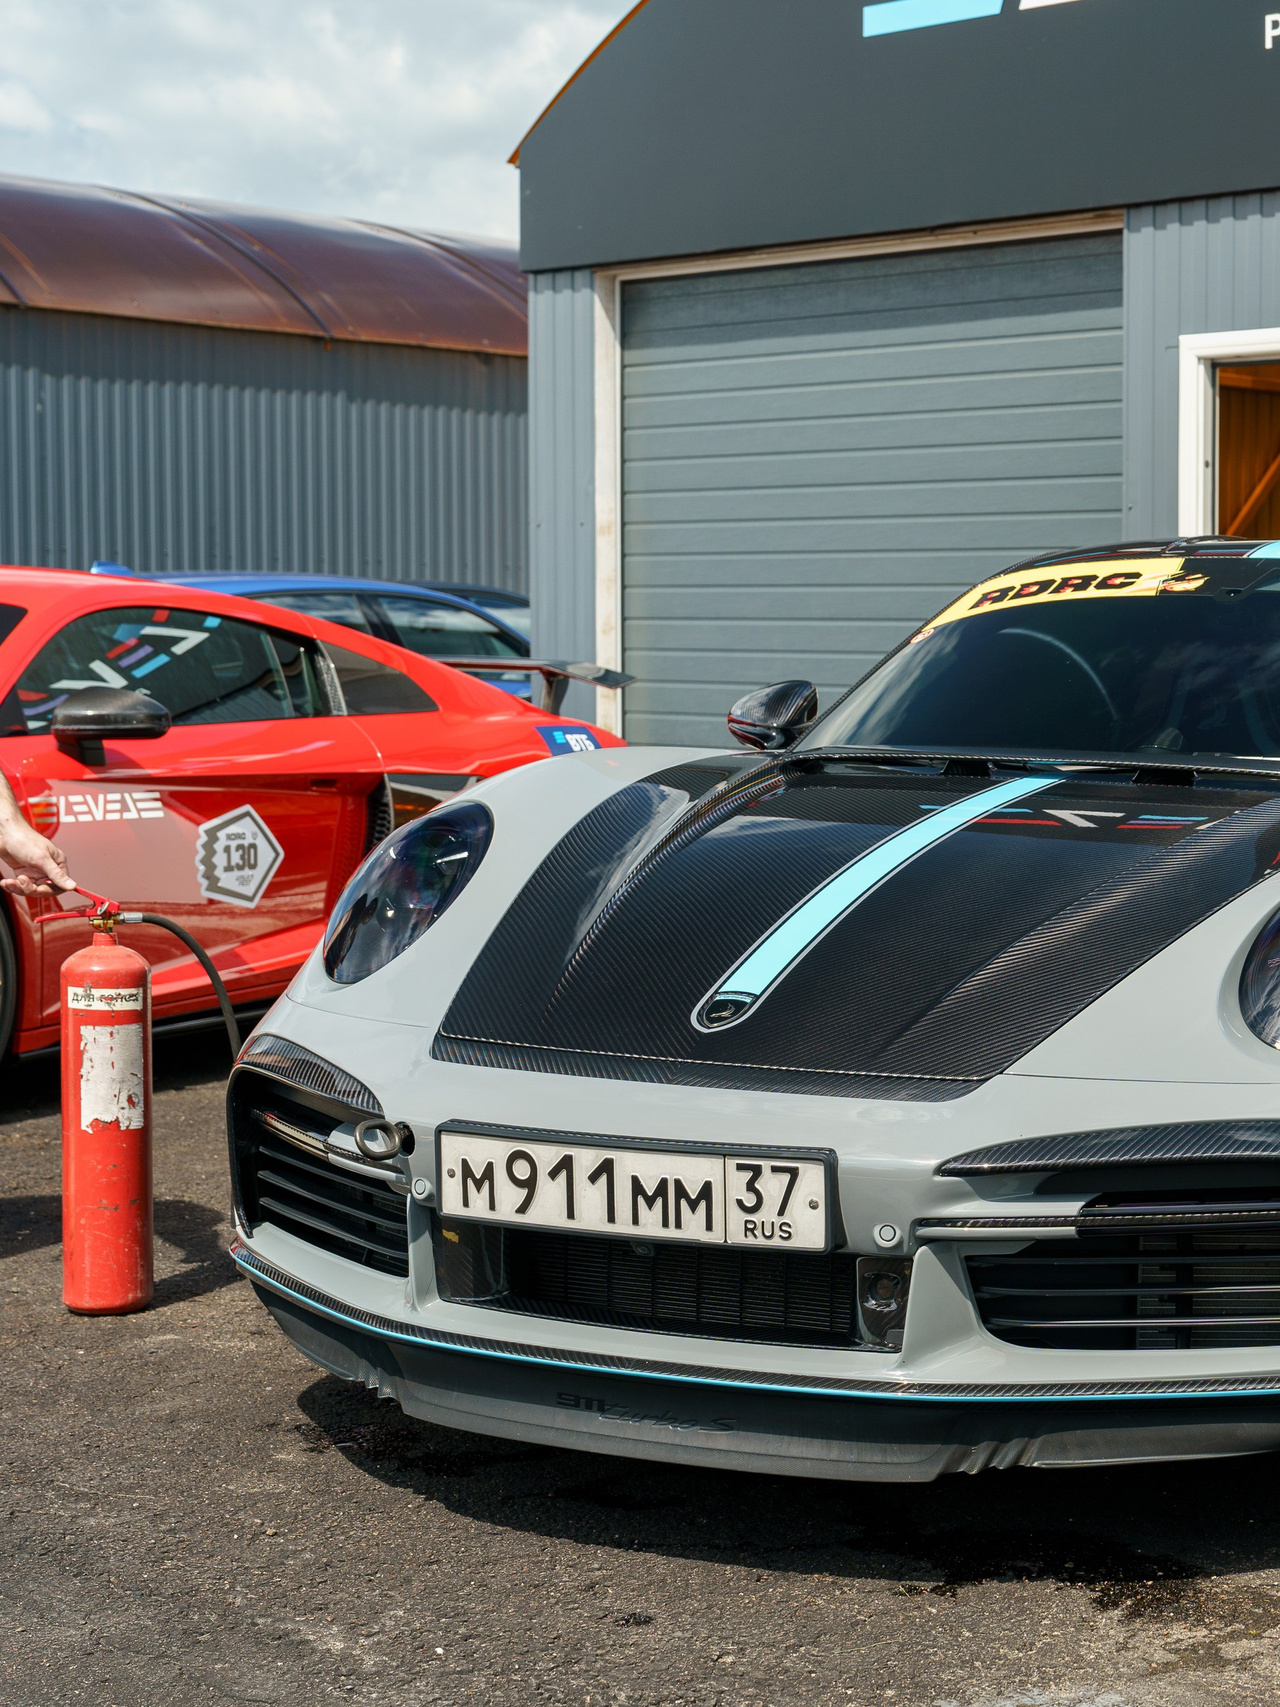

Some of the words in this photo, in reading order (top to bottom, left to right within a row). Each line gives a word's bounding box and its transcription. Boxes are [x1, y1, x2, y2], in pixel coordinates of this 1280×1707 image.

[967, 572, 1144, 611] RDRC
[223, 842, 258, 873] 130
[735, 1162, 801, 1217] 37
[743, 1218, 793, 1241] RUS
